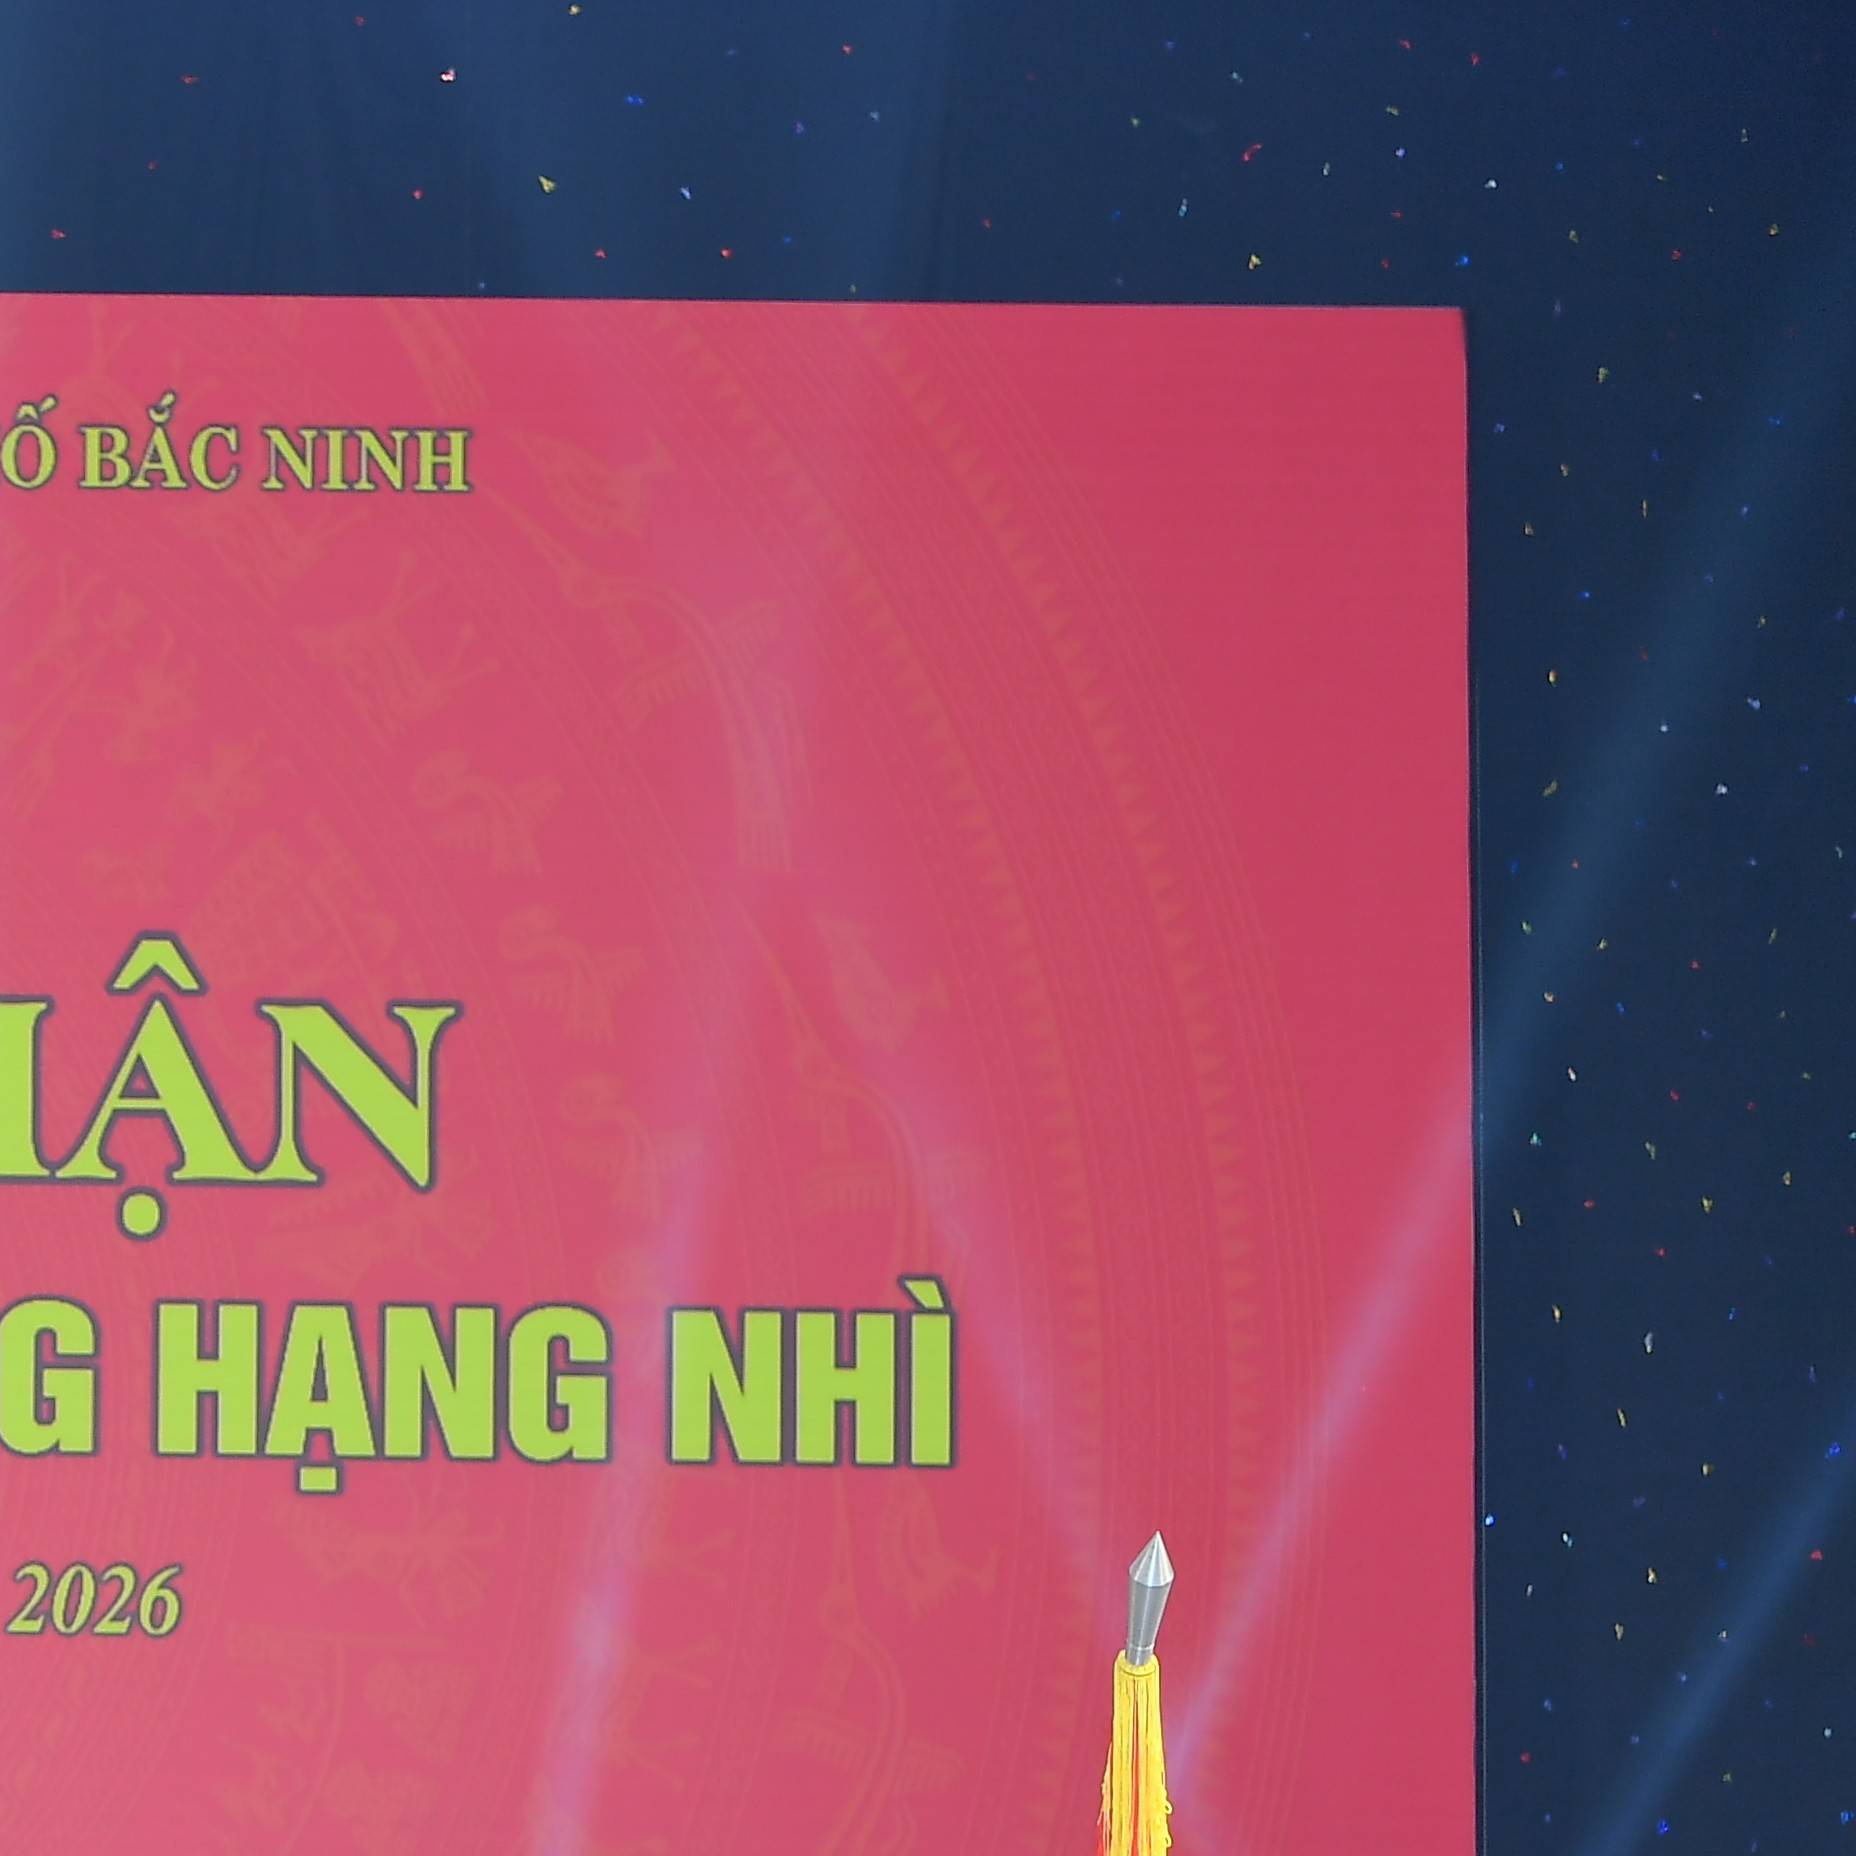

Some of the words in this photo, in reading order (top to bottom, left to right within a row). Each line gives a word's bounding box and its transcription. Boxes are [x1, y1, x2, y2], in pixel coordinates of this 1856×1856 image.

[82, 392, 240, 493] BẮC
[263, 426, 470, 494] NINH
[154, 1299, 612, 1496] HẠNG
[669, 1276, 955, 1469] NHÌ
[8, 1561, 182, 1637] 2026
